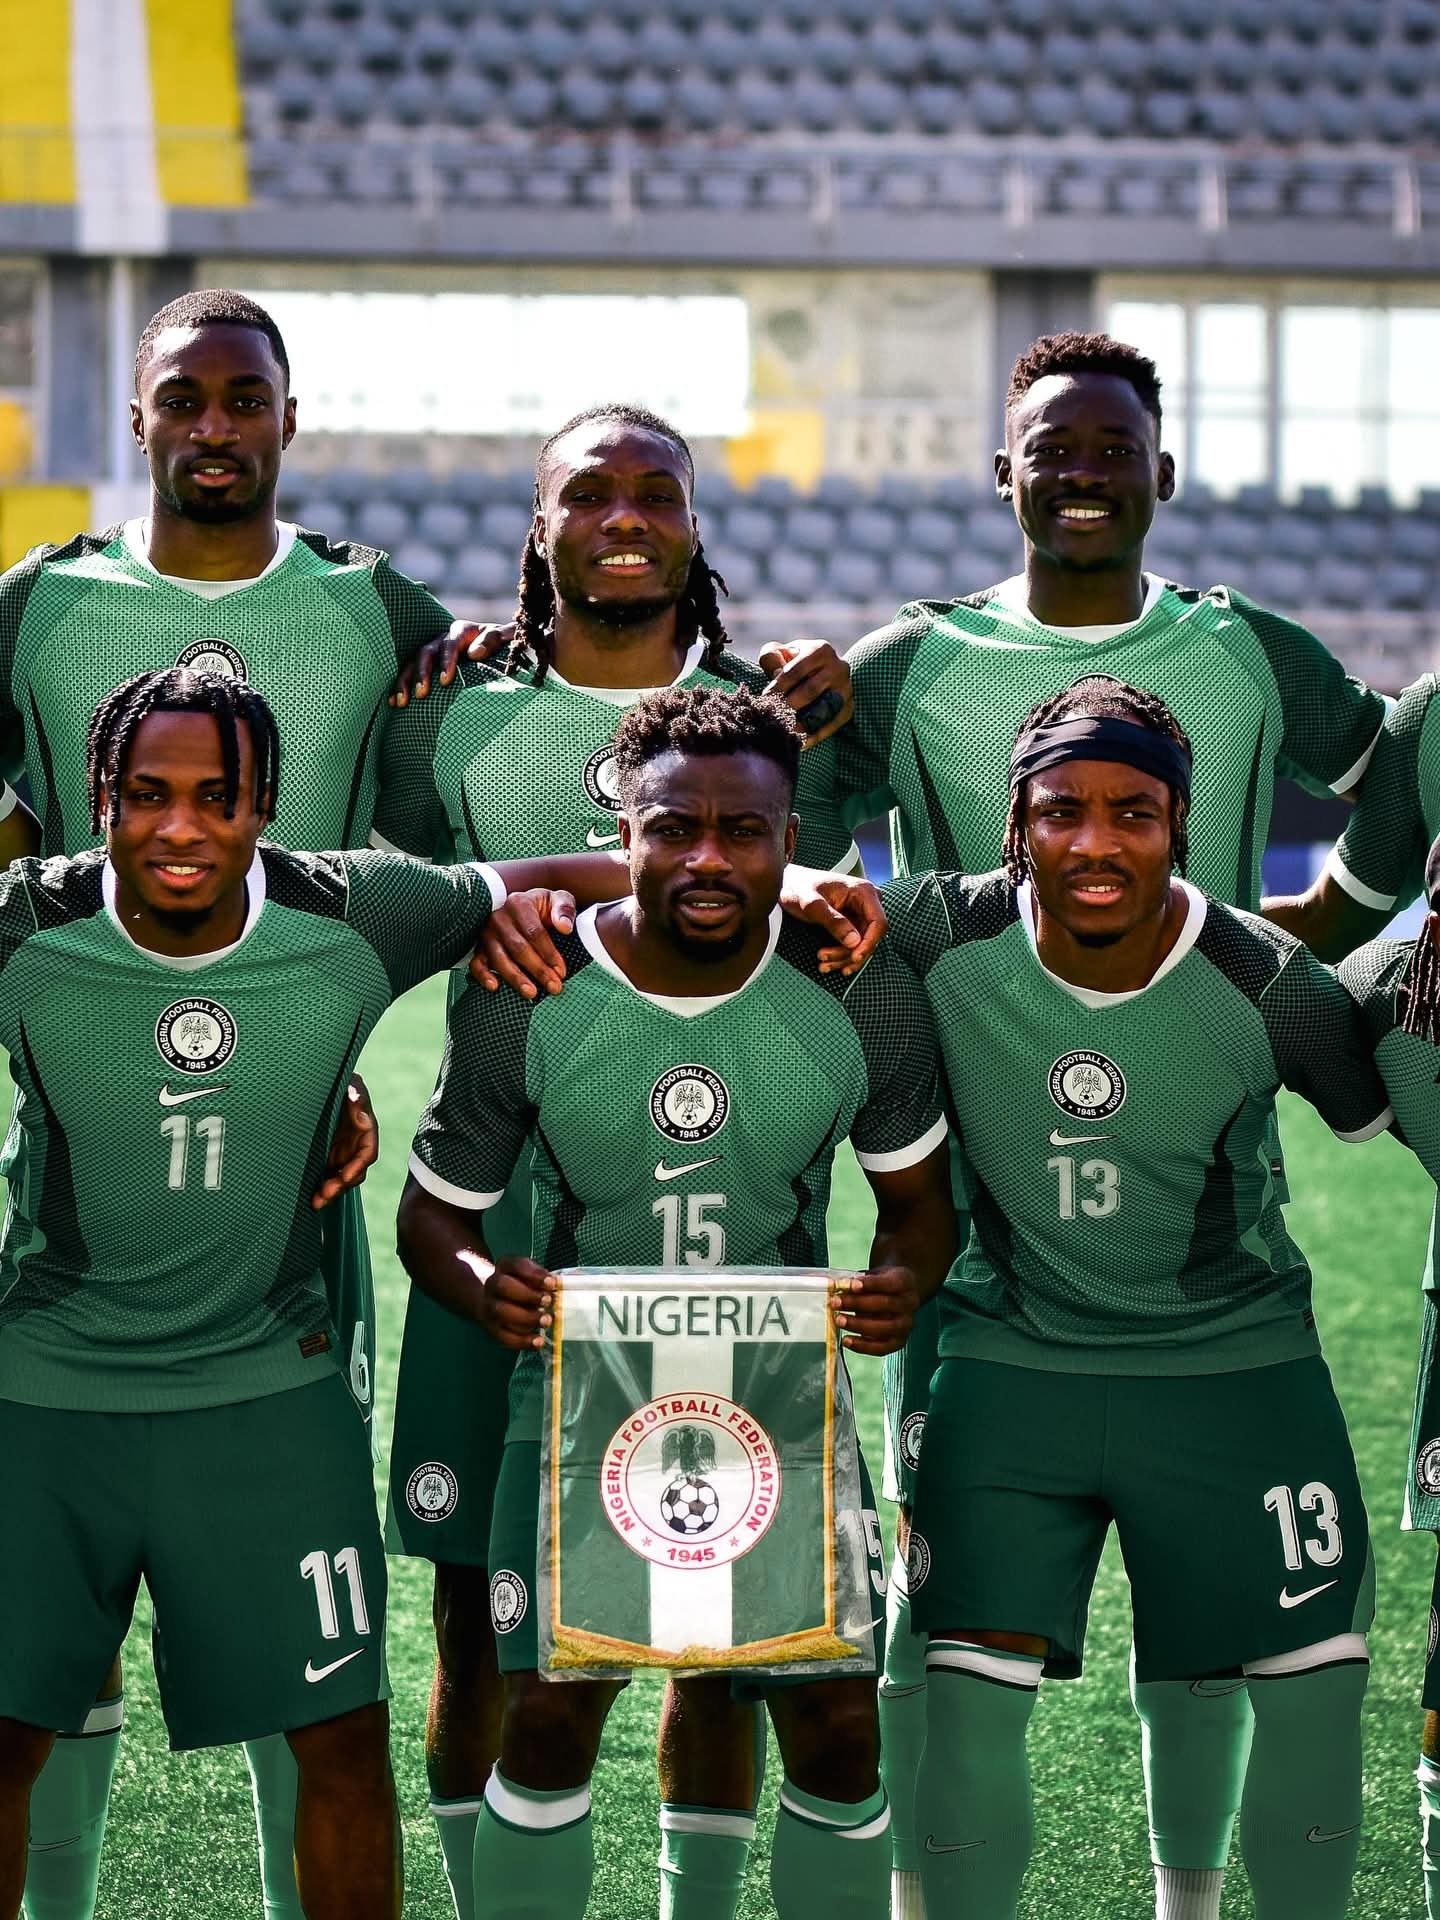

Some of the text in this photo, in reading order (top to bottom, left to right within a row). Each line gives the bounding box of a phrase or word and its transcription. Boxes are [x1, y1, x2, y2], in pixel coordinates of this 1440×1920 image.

[182, 642, 225, 663] FOOTBALL
[586, 766, 601, 799] NIGERIA
[160, 1001, 233, 1060] NIGERIA FOOTBALL FEDERATION
[185, 1060, 207, 1070] 1945
[1052, 1053, 1122, 1111] NIGERIA FOOTBALL FEDERATION
[653, 1068, 725, 1129] NIGERIA FOOTBALL FEDERATION
[1076, 1107, 1097, 1116] 1945
[160, 1114, 226, 1191] 11
[679, 1129, 700, 1139] 1945
[1047, 1156, 1121, 1220] 13
[652, 1193, 727, 1273] 15
[598, 1295, 791, 1337] NIGERIA
[606, 1399, 774, 1532] NIGERIA FOOTBALL FEDERATION
[1263, 1481, 1343, 1570] 13
[666, 1547, 717, 1563] 1945
[300, 1547, 371, 1640] 11
